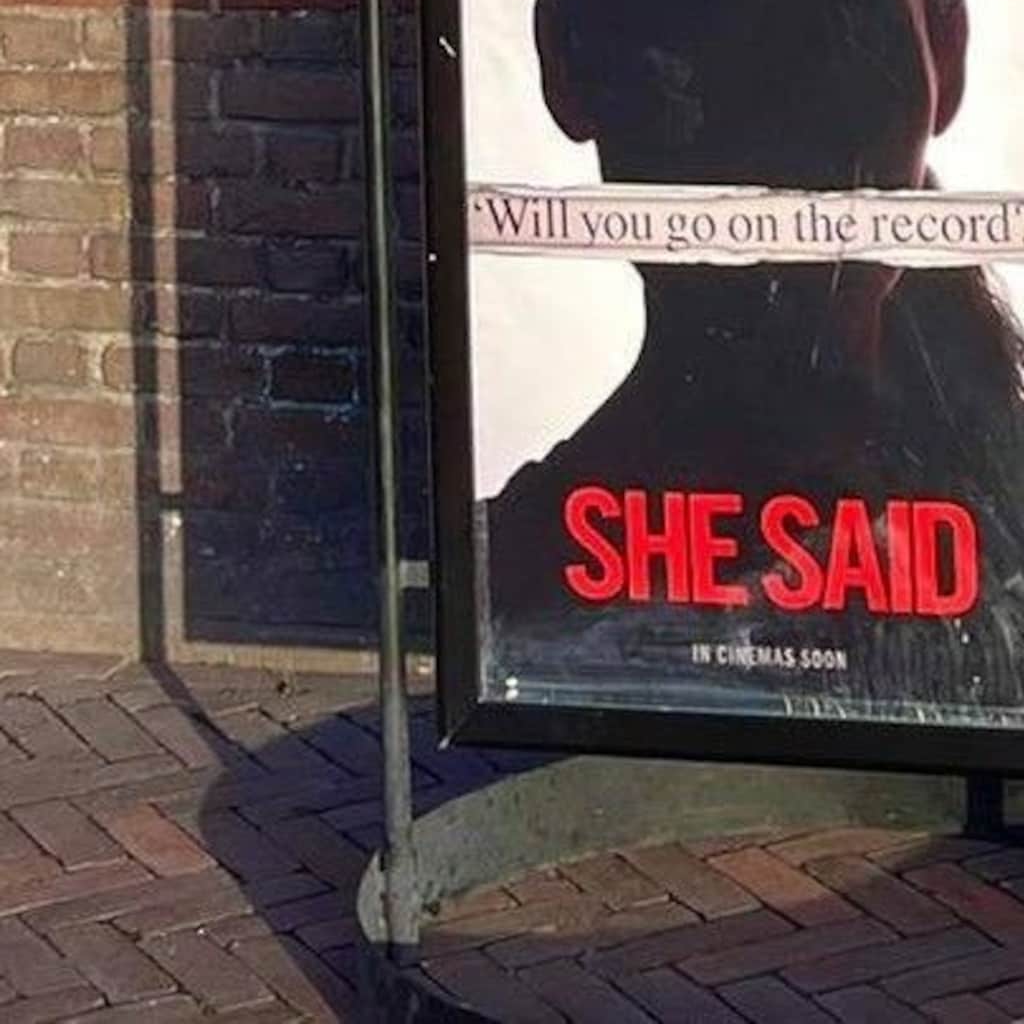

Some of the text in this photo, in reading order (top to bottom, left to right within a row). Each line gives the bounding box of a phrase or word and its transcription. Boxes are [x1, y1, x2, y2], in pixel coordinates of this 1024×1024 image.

[581, 211, 652, 247] you
[666, 213, 716, 251] go
[728, 213, 778, 242] on
[795, 203, 857, 243] the
[563, 486, 981, 617] SHE SAID
[691, 644, 848, 669] IN CINEMAS SOON
